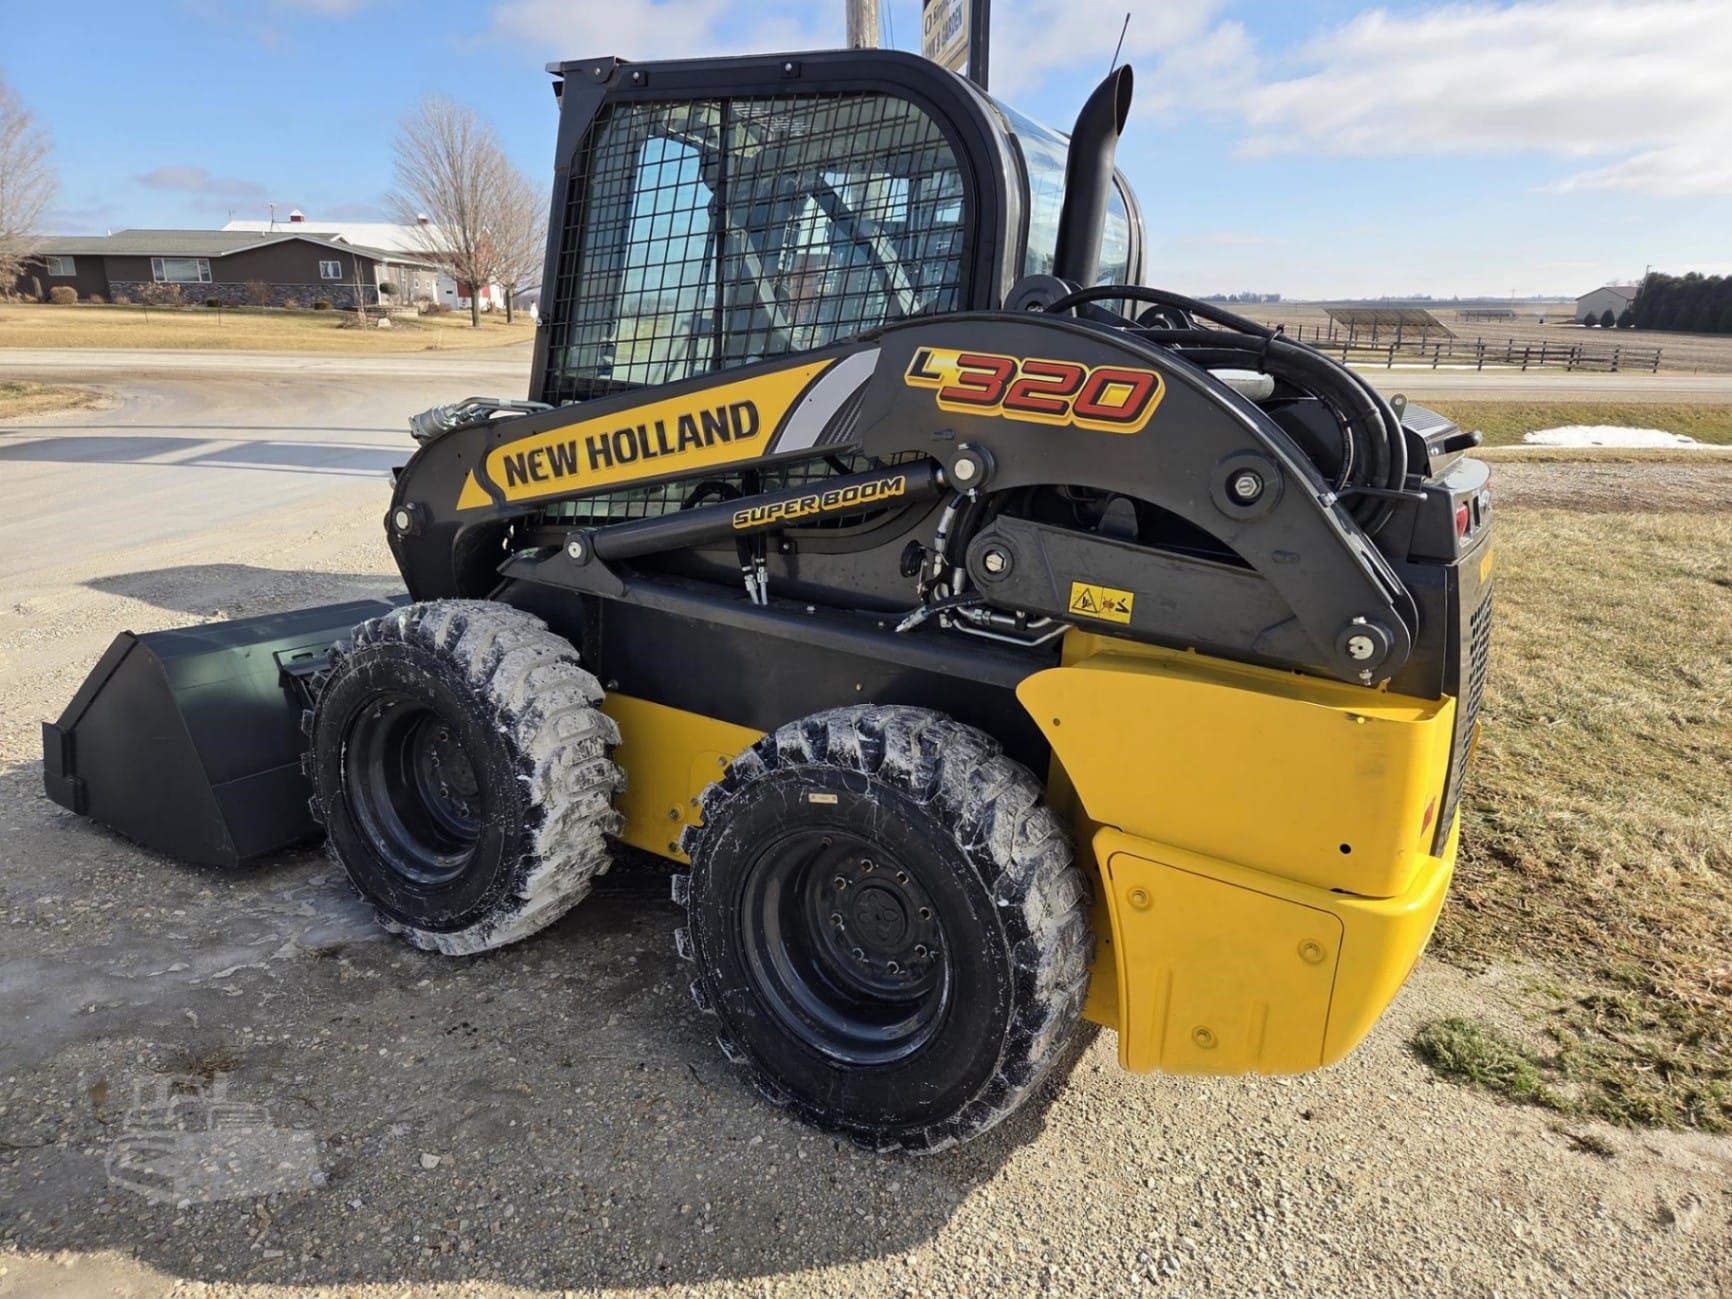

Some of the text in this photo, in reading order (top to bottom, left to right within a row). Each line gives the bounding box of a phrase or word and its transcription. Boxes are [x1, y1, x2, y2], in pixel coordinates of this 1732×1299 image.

[905, 347, 1165, 433] L320
[503, 399, 760, 488] NEW HOLLAND
[732, 475, 906, 529] SUPER BOOM
